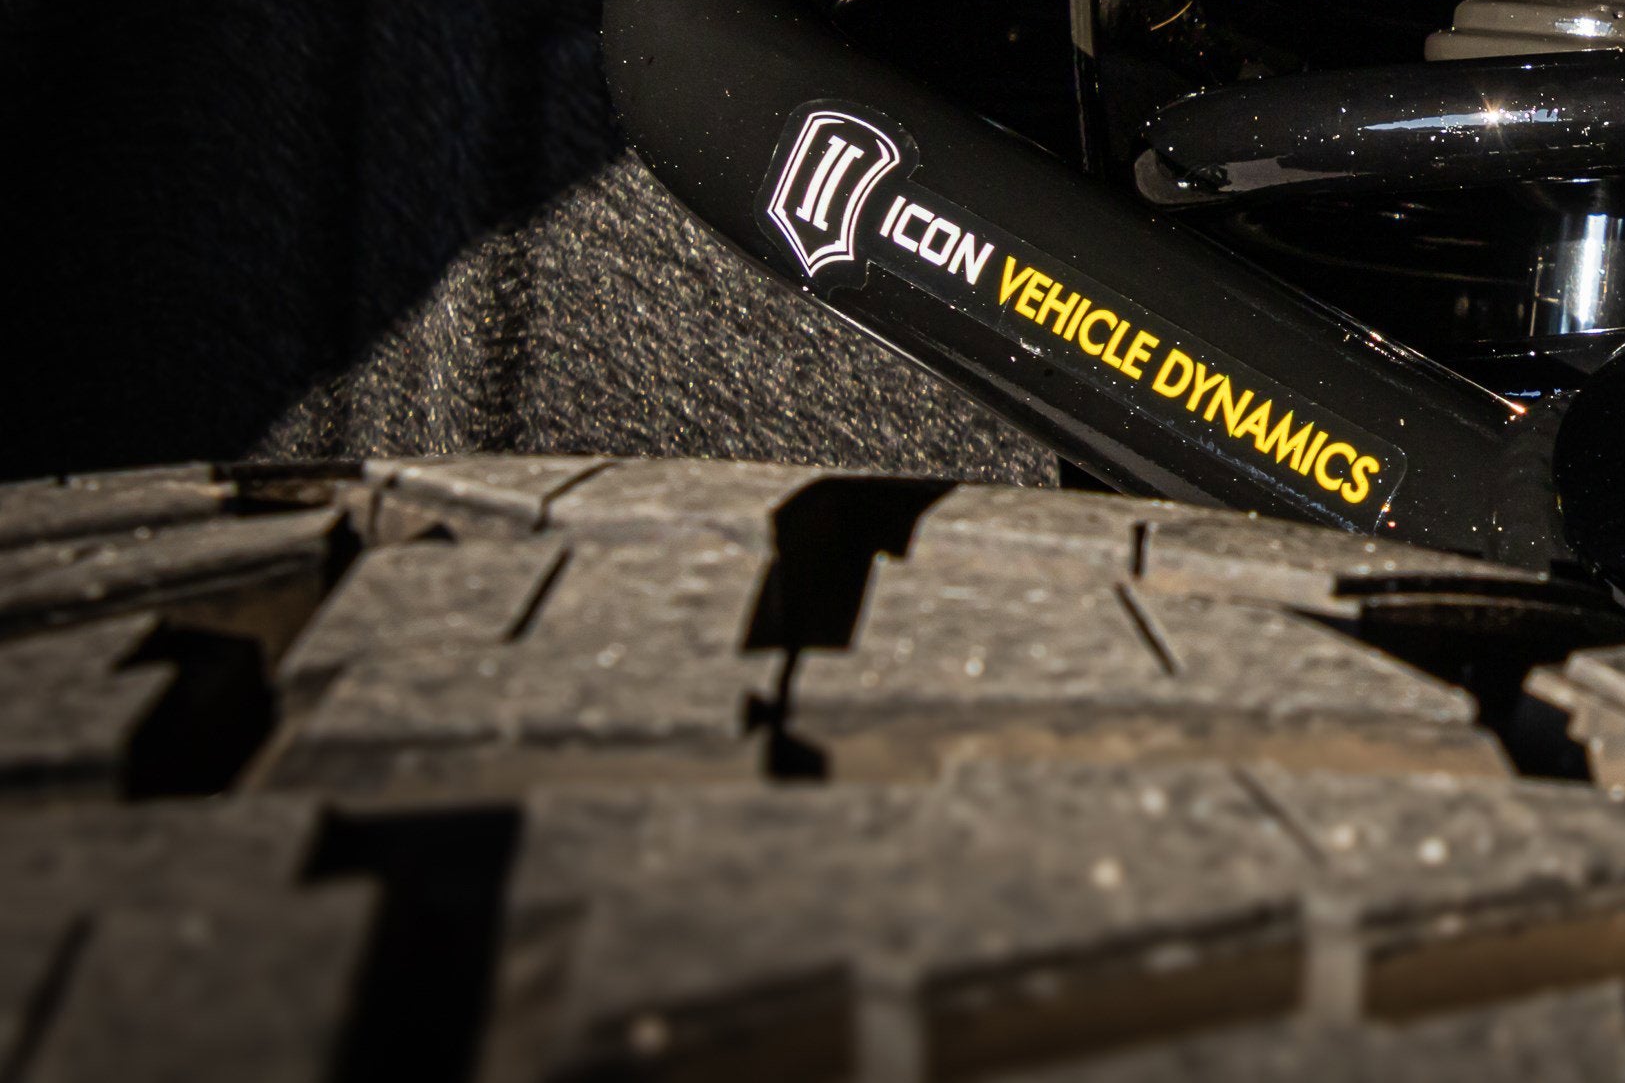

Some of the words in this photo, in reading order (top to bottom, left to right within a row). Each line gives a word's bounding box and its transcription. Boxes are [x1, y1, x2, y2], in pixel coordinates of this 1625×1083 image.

[879, 195, 995, 286] ICON
[998, 255, 1161, 381] VEHICLE
[1151, 348, 1381, 505] DYNAMICS
